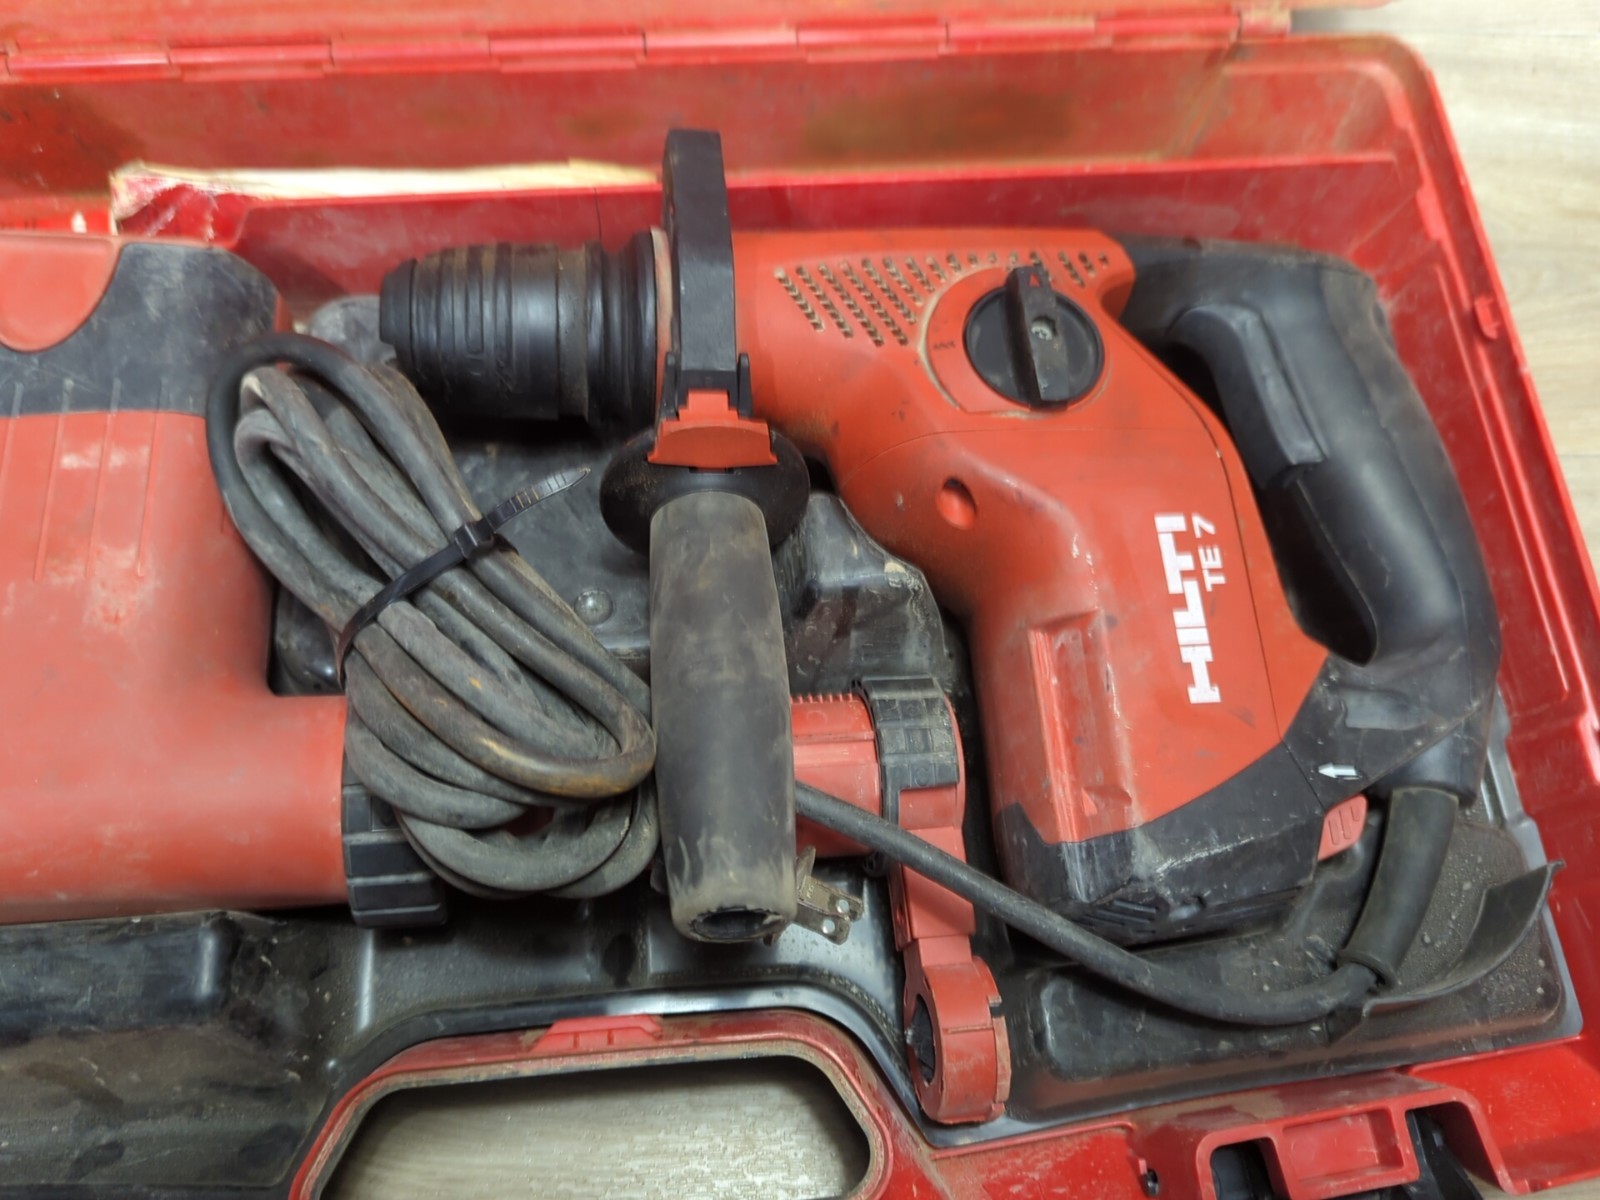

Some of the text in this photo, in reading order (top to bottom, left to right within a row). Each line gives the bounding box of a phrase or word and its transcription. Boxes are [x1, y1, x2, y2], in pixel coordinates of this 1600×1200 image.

[1153, 512, 1222, 705] HILTI
[1191, 512, 1227, 592] TE 7
